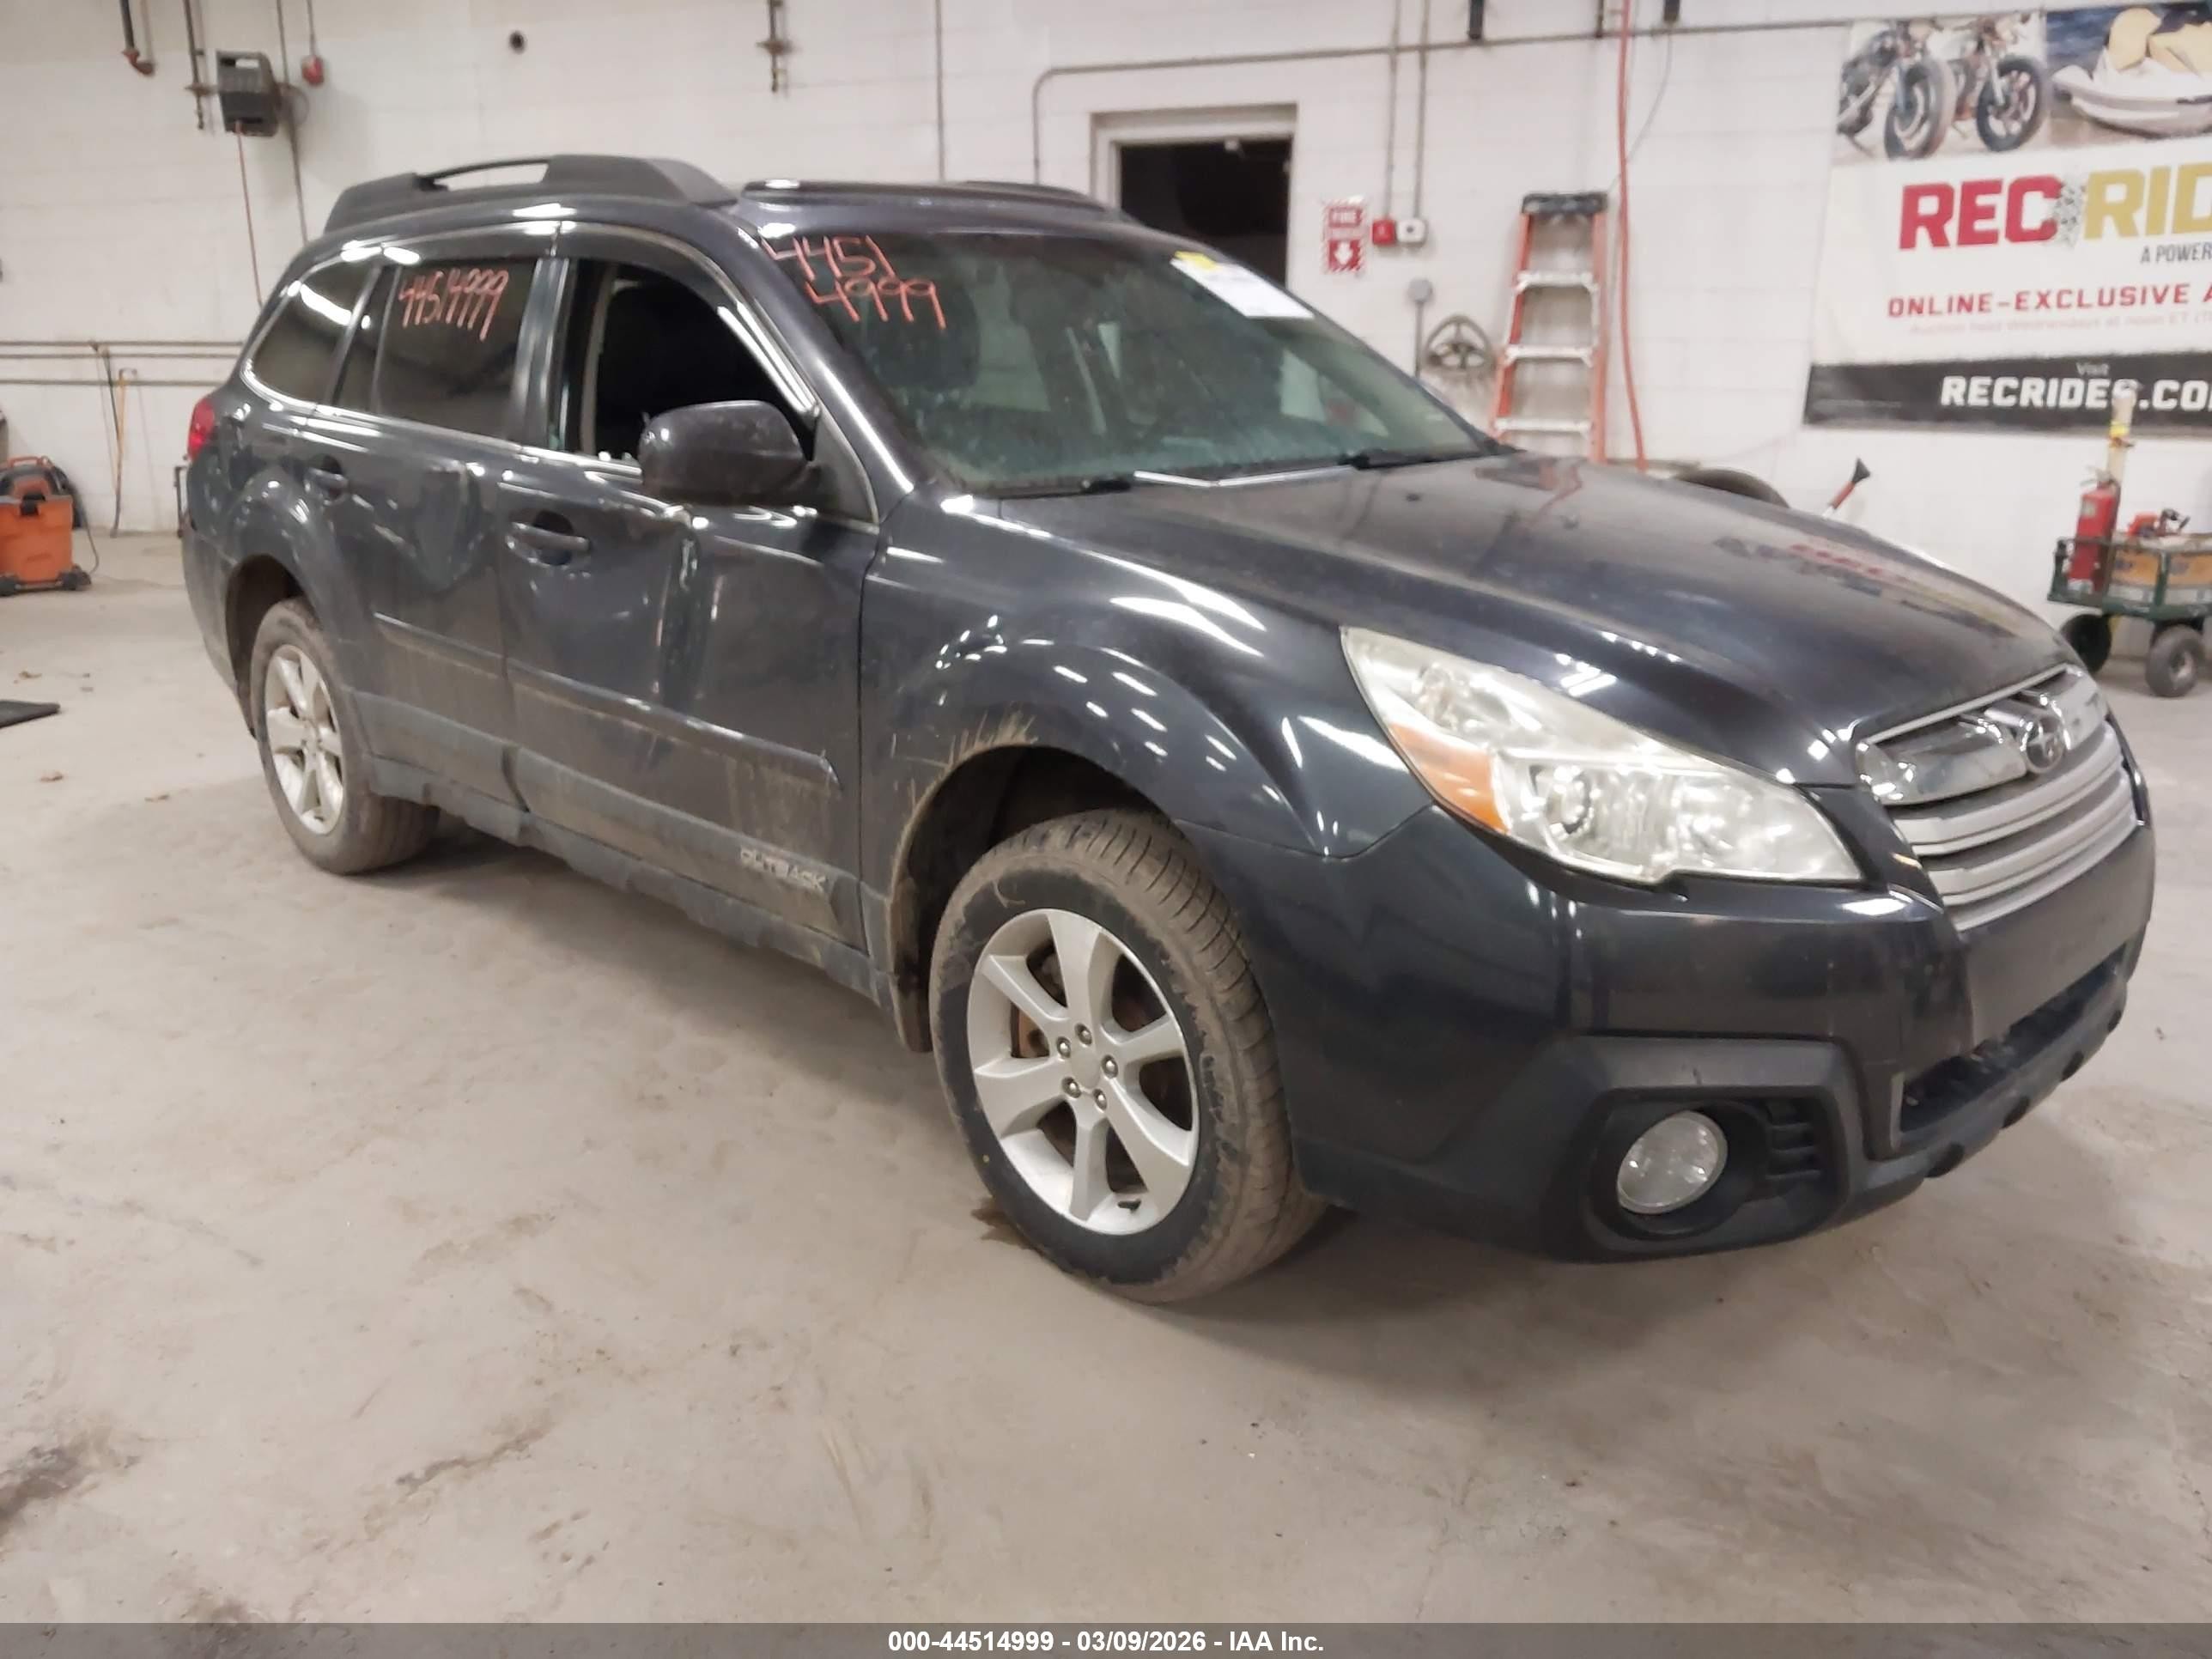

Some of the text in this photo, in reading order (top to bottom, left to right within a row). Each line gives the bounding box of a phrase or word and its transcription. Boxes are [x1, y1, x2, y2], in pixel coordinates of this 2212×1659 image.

[1899, 175, 2063, 250] REC
[760, 234, 896, 283] 4451
[2140, 245, 2151, 264] A
[804, 276, 946, 330] 4999
[1887, 283, 2191, 318] ONLINE-EXCLUSIVE
